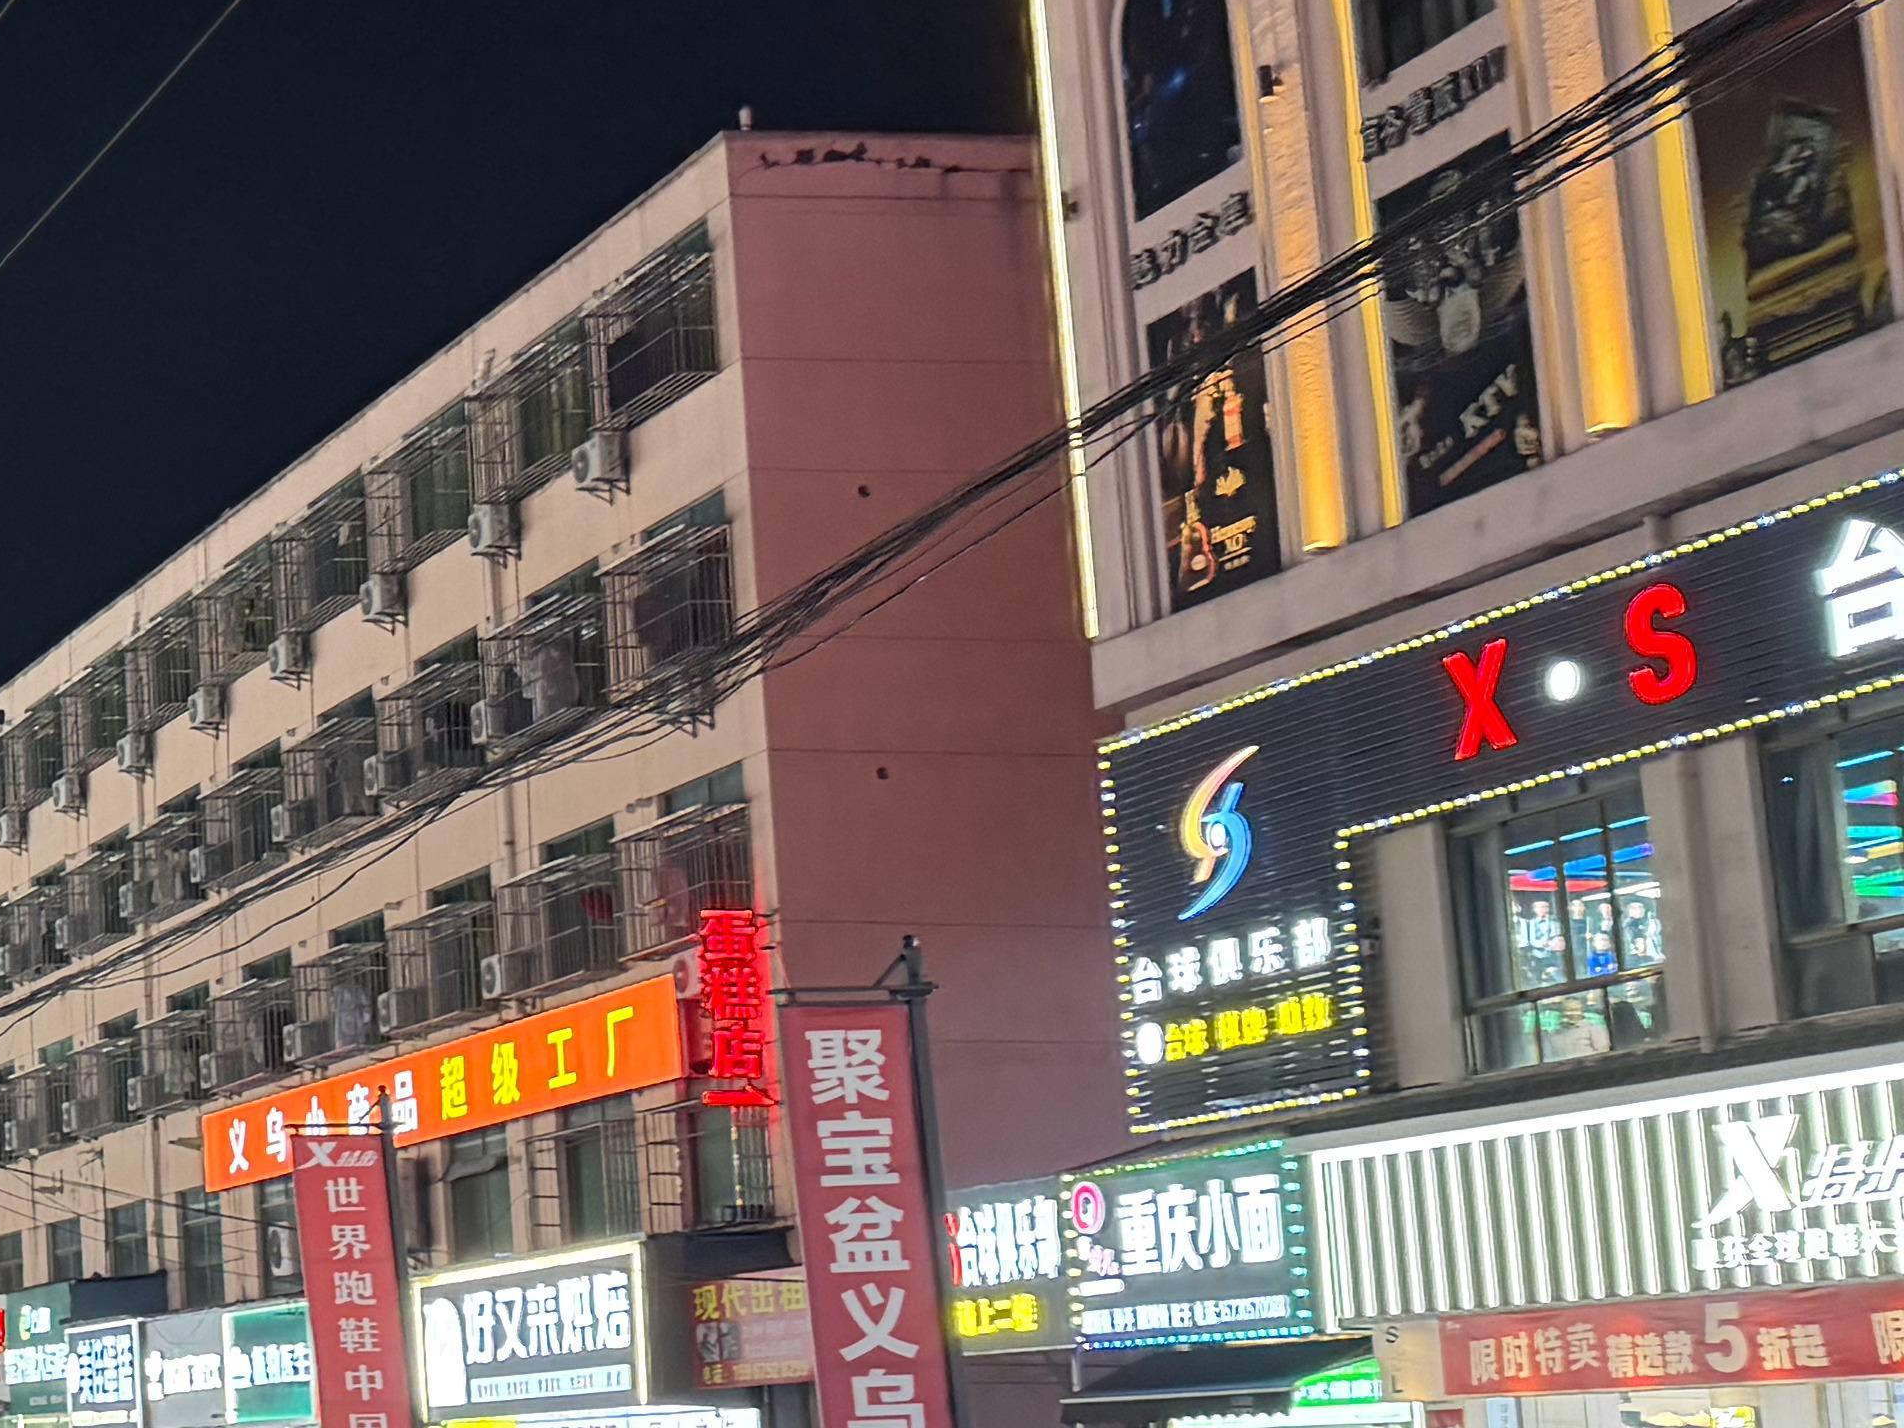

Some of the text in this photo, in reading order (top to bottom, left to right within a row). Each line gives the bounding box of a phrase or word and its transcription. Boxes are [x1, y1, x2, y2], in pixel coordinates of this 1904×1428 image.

[1458, 363, 1518, 440] KTV
[700, 910, 763, 1078] 蛋糕店
[1130, 917, 1331, 1005] 台球俱乐部
[1117, 1174, 1284, 1276] 重庆小面
[462, 1270, 632, 1365] 好又来烘焙
